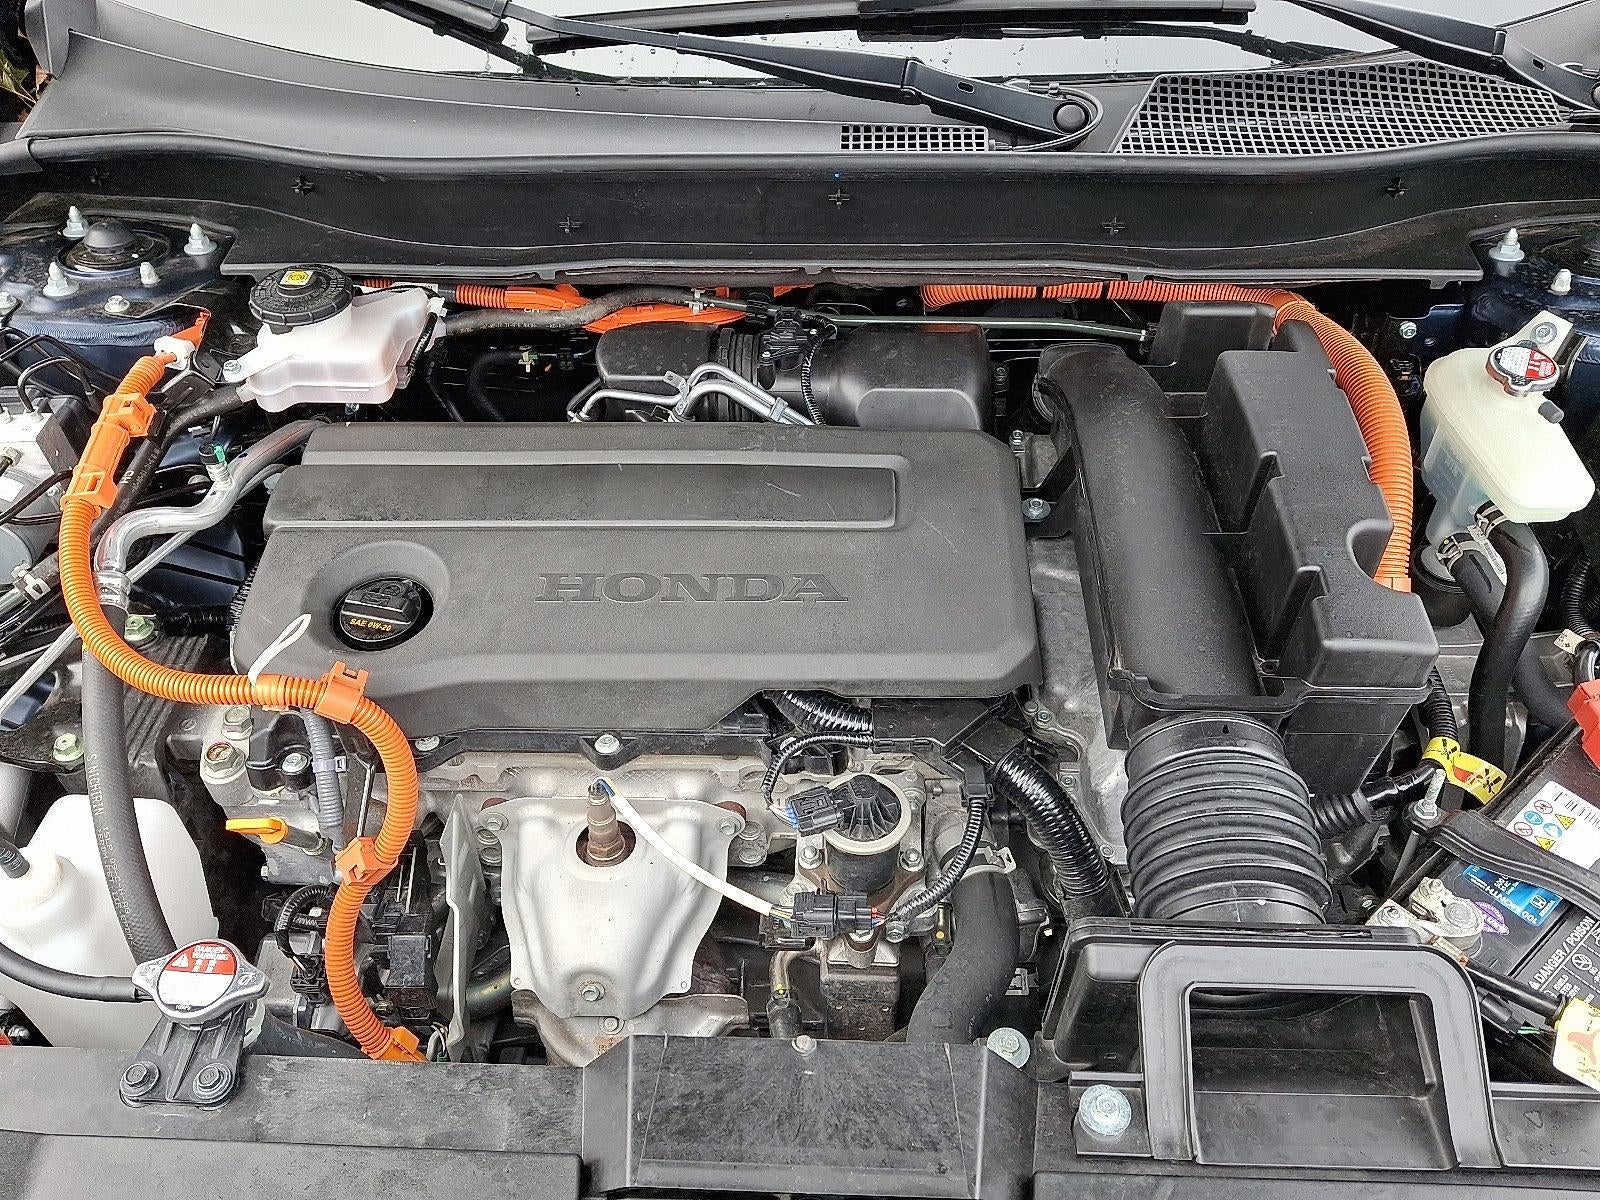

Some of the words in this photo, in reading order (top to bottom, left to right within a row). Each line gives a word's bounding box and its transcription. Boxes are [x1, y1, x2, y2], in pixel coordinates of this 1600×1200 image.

[534, 573, 848, 603] HONDA
[349, 618, 368, 627] SAE
[367, 622, 392, 632] 0W-20
[87, 765, 105, 816] NICHIRIN
[1484, 885, 1522, 914] MONTH
[1533, 948, 1565, 983] DANGER
[1566, 915, 1596, 947] POISON
